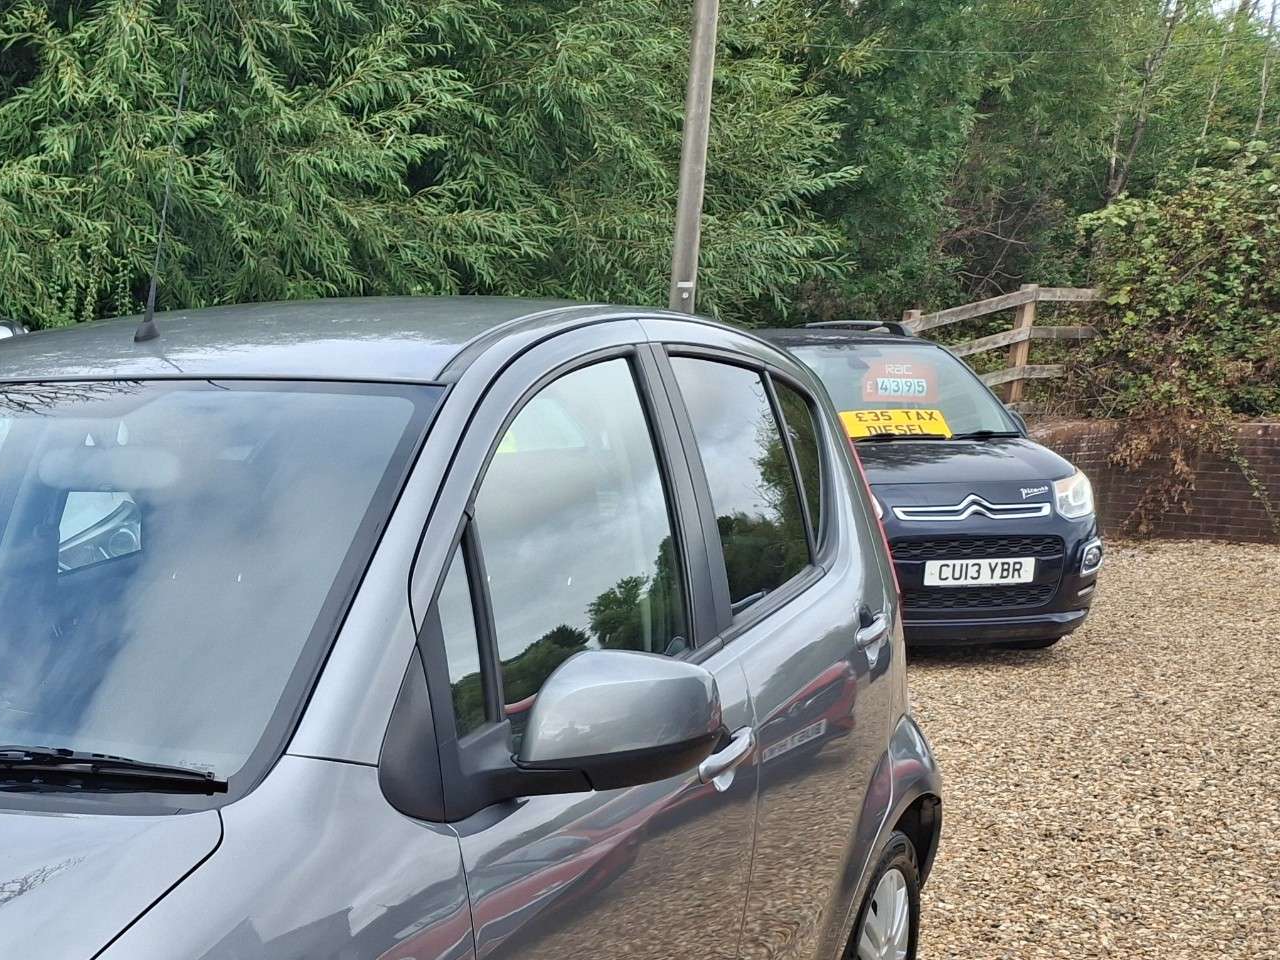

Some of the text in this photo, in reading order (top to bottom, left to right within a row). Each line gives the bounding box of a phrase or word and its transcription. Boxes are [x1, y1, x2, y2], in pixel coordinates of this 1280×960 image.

[855, 411, 938, 422] £35 TAX
[938, 561, 1023, 580] CU13 YBR
